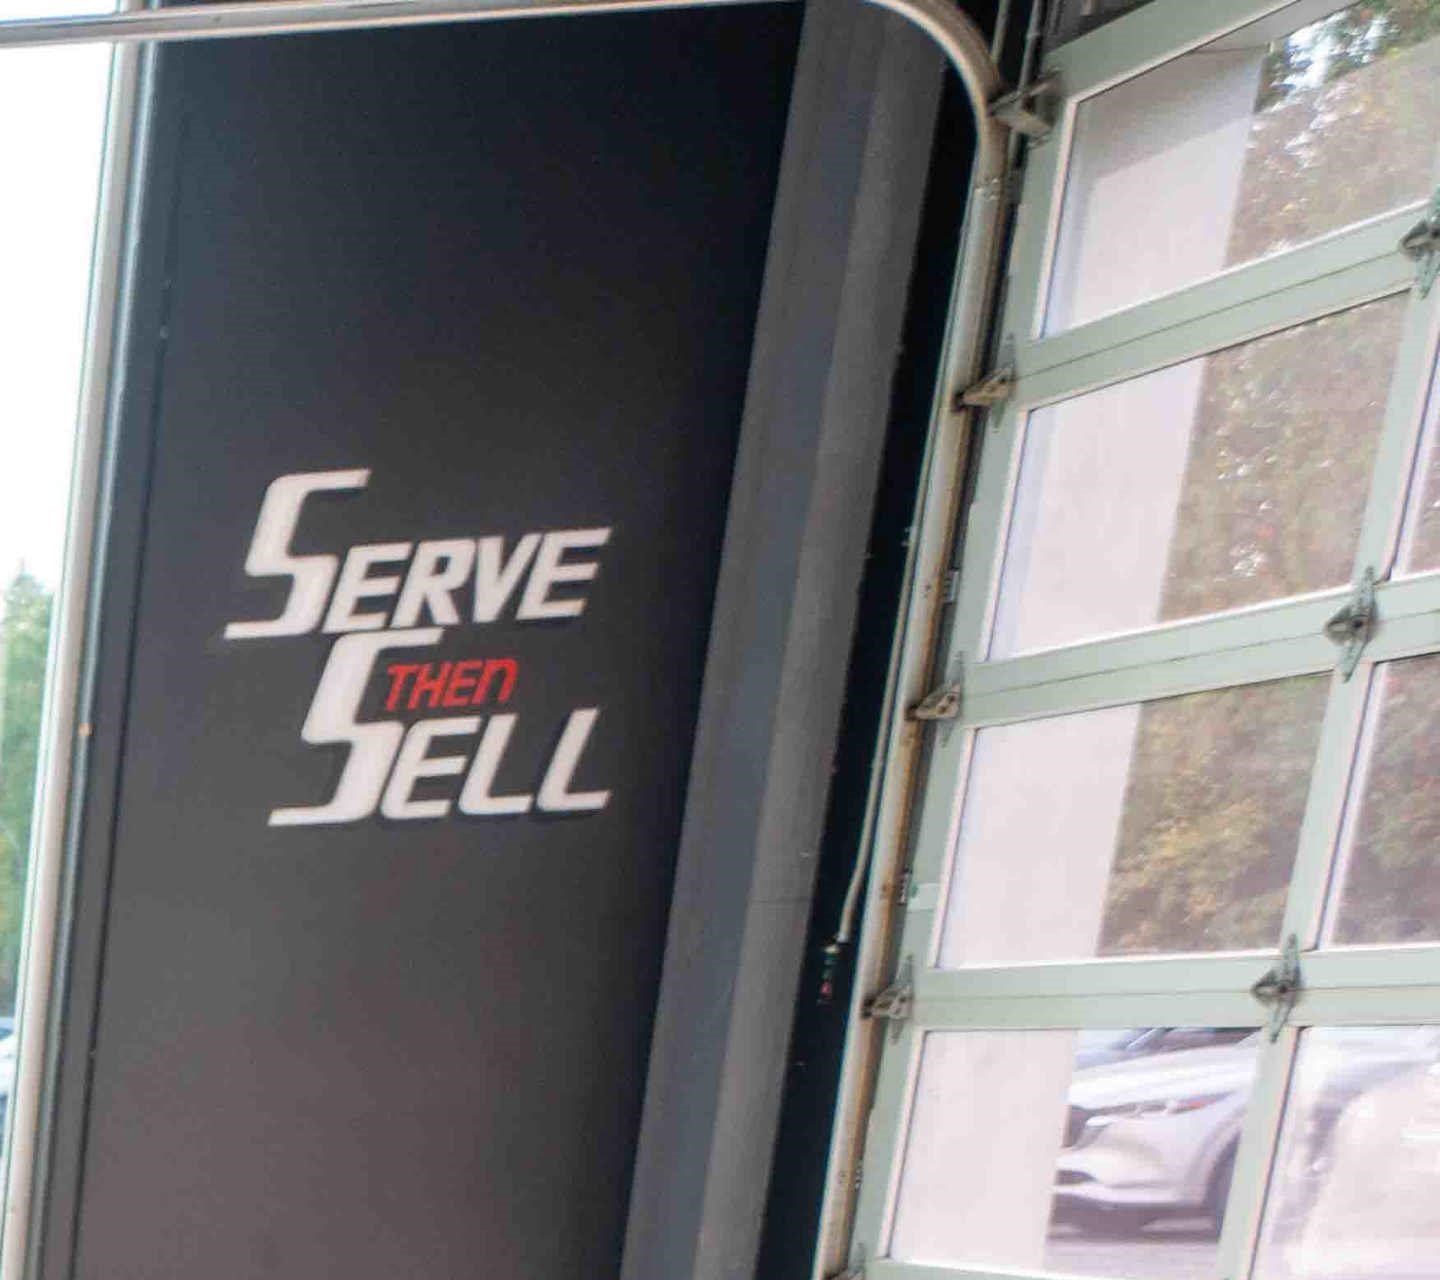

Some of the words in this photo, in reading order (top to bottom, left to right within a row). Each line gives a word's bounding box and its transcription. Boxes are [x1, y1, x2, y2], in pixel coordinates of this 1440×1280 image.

[223, 468, 612, 640] SERVE
[268, 627, 611, 826] SELL
[383, 658, 518, 712] THEN
